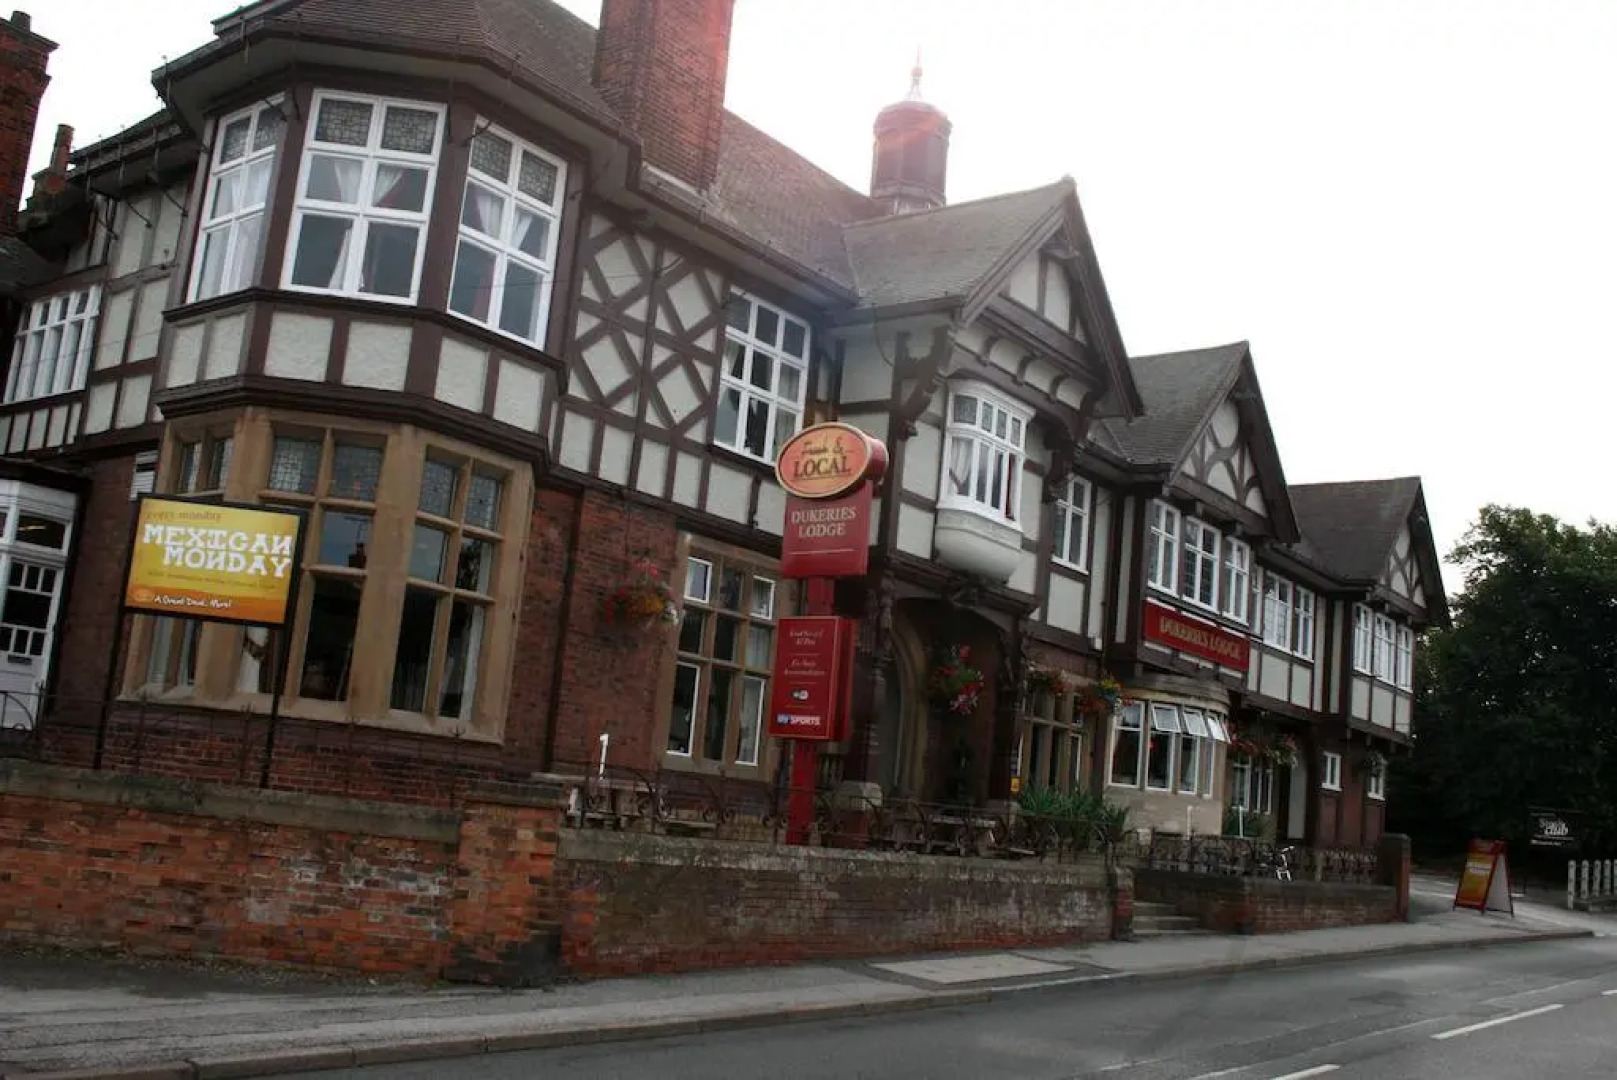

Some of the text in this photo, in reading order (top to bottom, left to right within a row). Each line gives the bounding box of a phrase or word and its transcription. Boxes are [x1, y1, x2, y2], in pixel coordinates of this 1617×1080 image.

[793, 455, 852, 478] LOCAL
[791, 506, 857, 524] DUKERIES
[798, 522, 846, 538] LODGE
[790, 715, 820, 726] SPORTS
